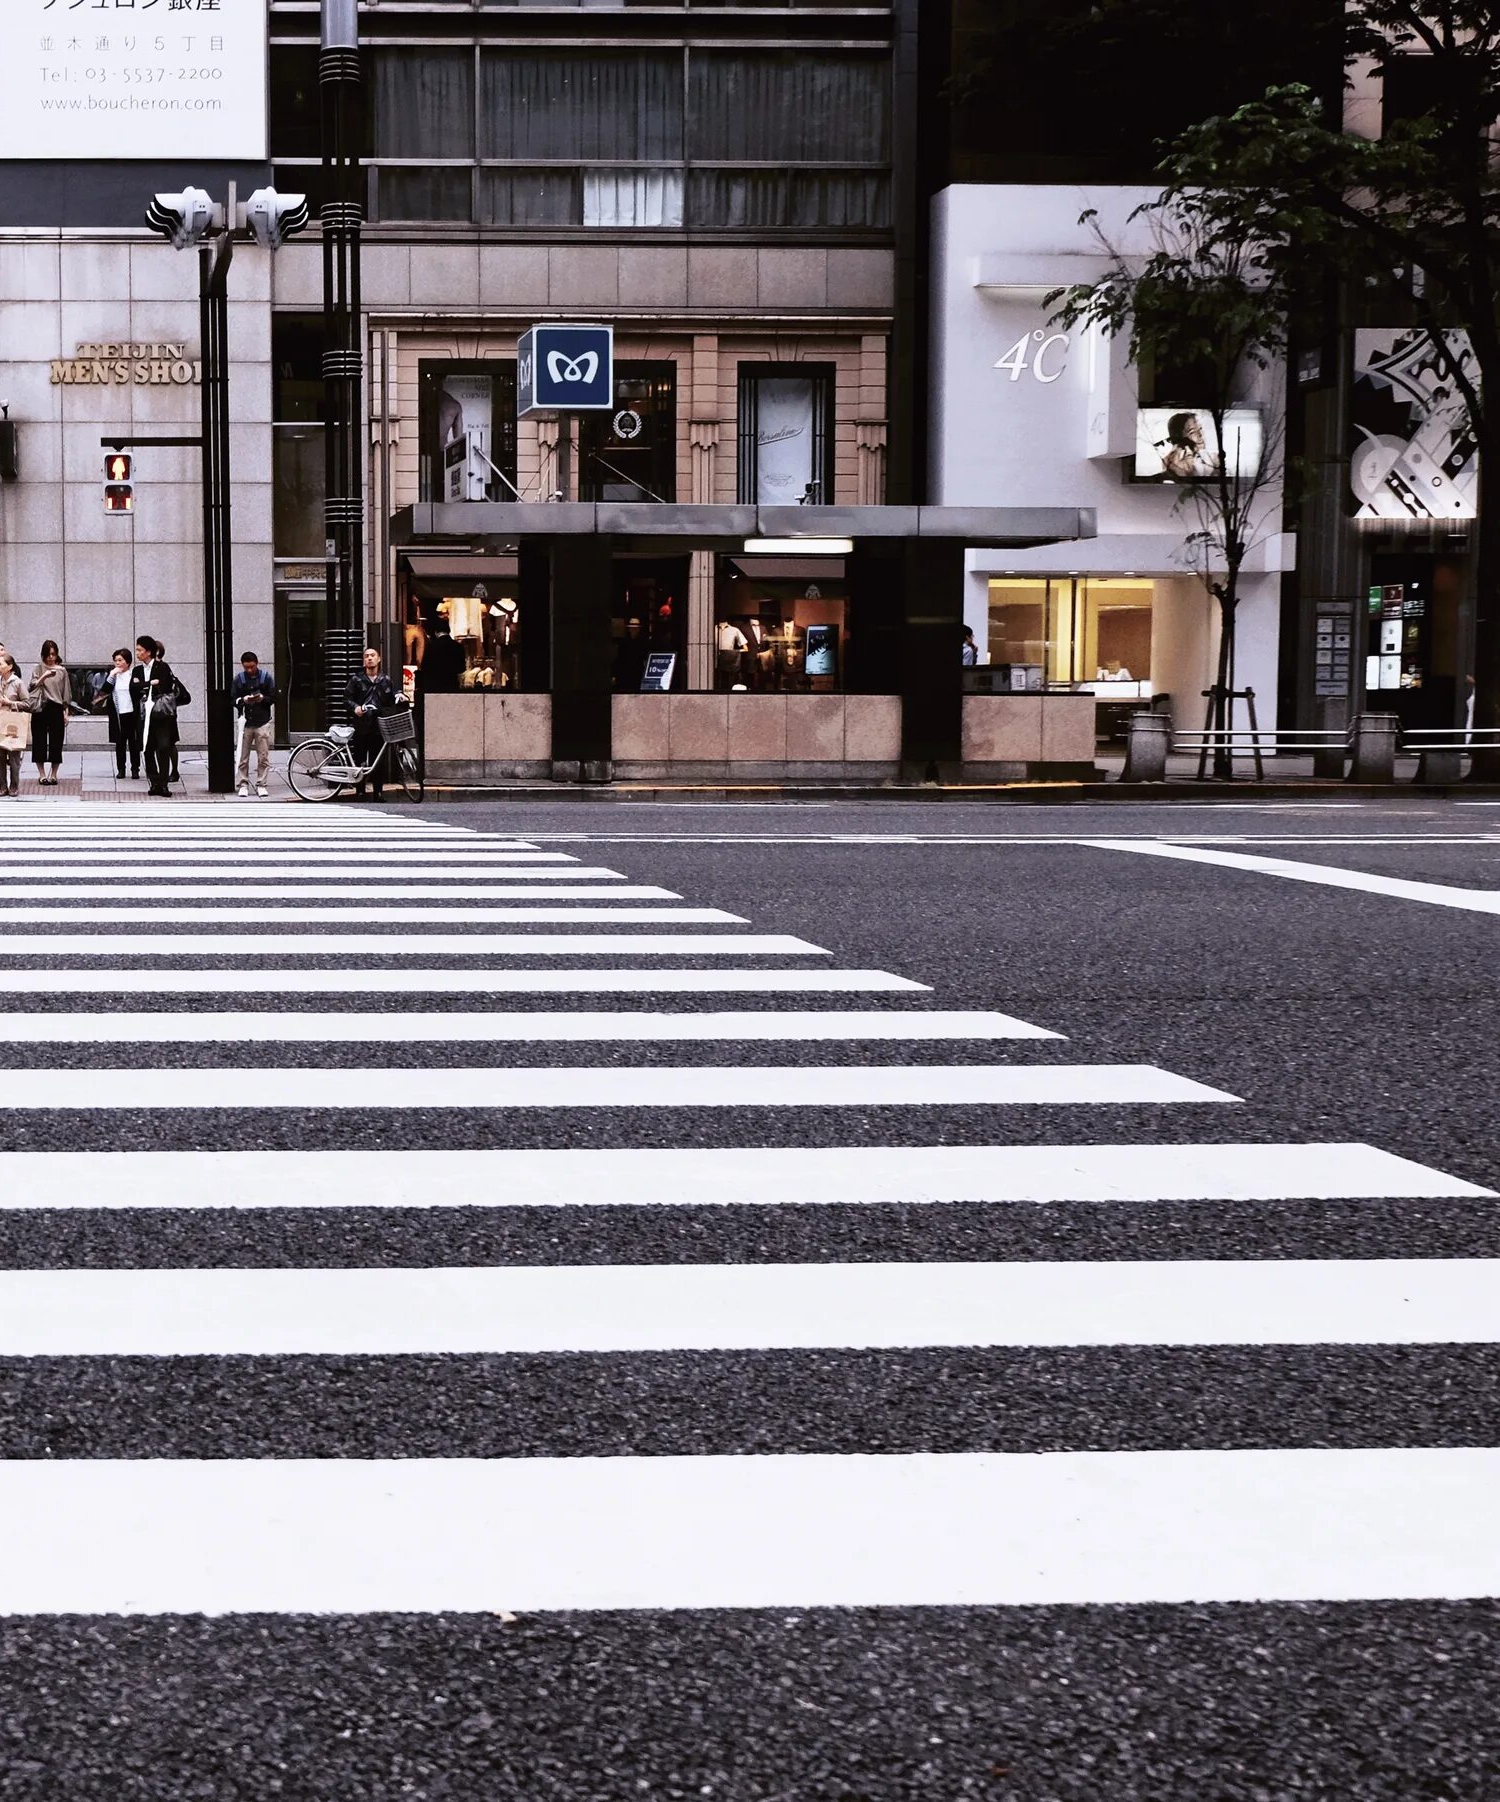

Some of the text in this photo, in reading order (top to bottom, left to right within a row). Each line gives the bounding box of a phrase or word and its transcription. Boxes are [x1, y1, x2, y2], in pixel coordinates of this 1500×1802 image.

[40, 36, 223, 51] 並木通り5丁目
[85, 68, 222, 83] 03-5537-2200
[40, 95, 222, 110] www.boucheron.com
[77, 343, 185, 360] TEIJIN
[51, 361, 130, 385] MEN'S
